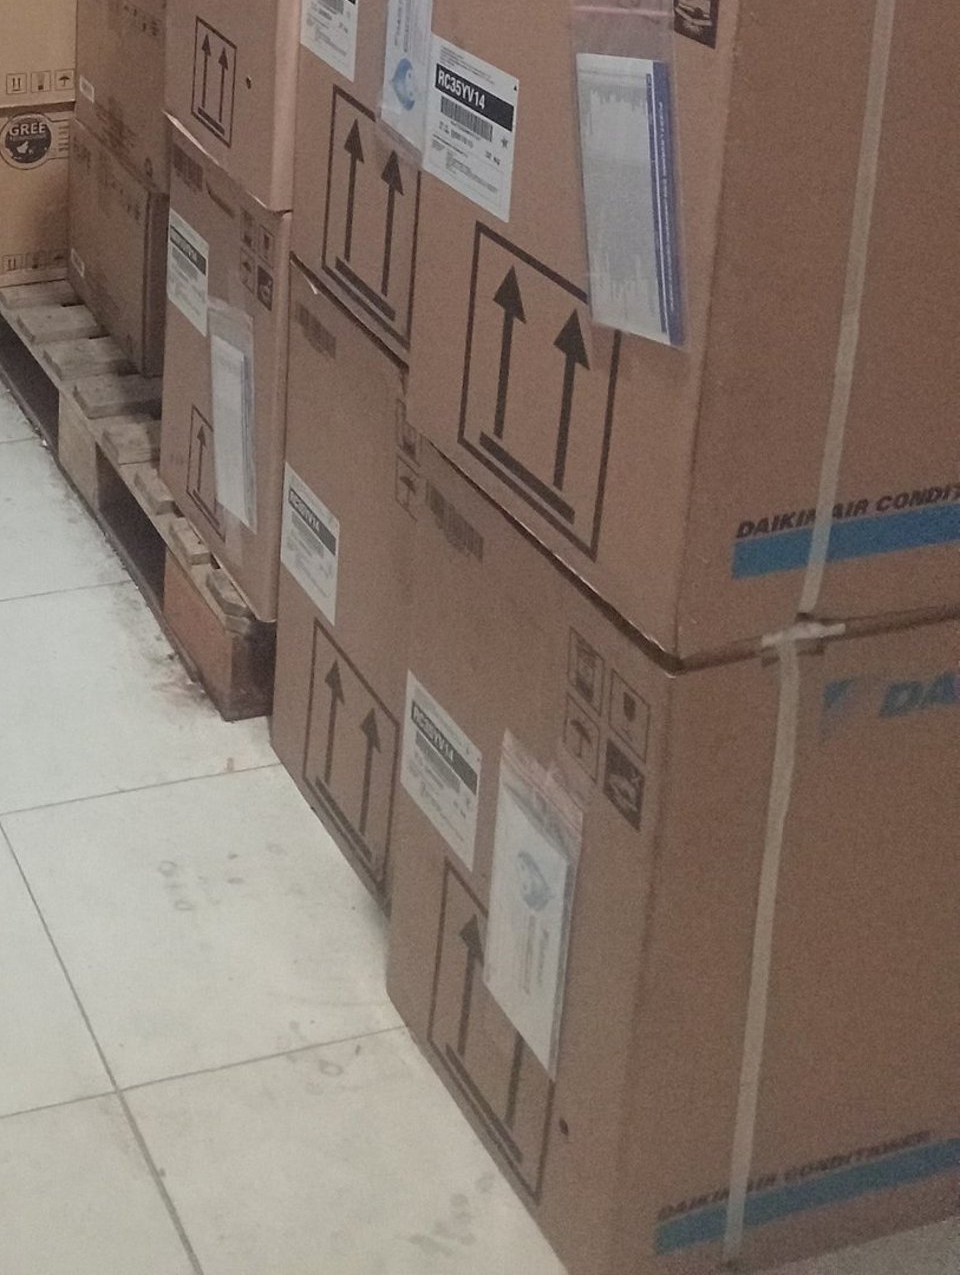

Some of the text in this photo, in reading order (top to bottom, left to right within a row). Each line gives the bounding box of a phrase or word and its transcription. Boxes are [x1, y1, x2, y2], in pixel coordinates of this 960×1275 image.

[438, 70, 485, 110] RC35YV14
[10, 121, 47, 136] GREE
[832, 499, 870, 519] AIR
